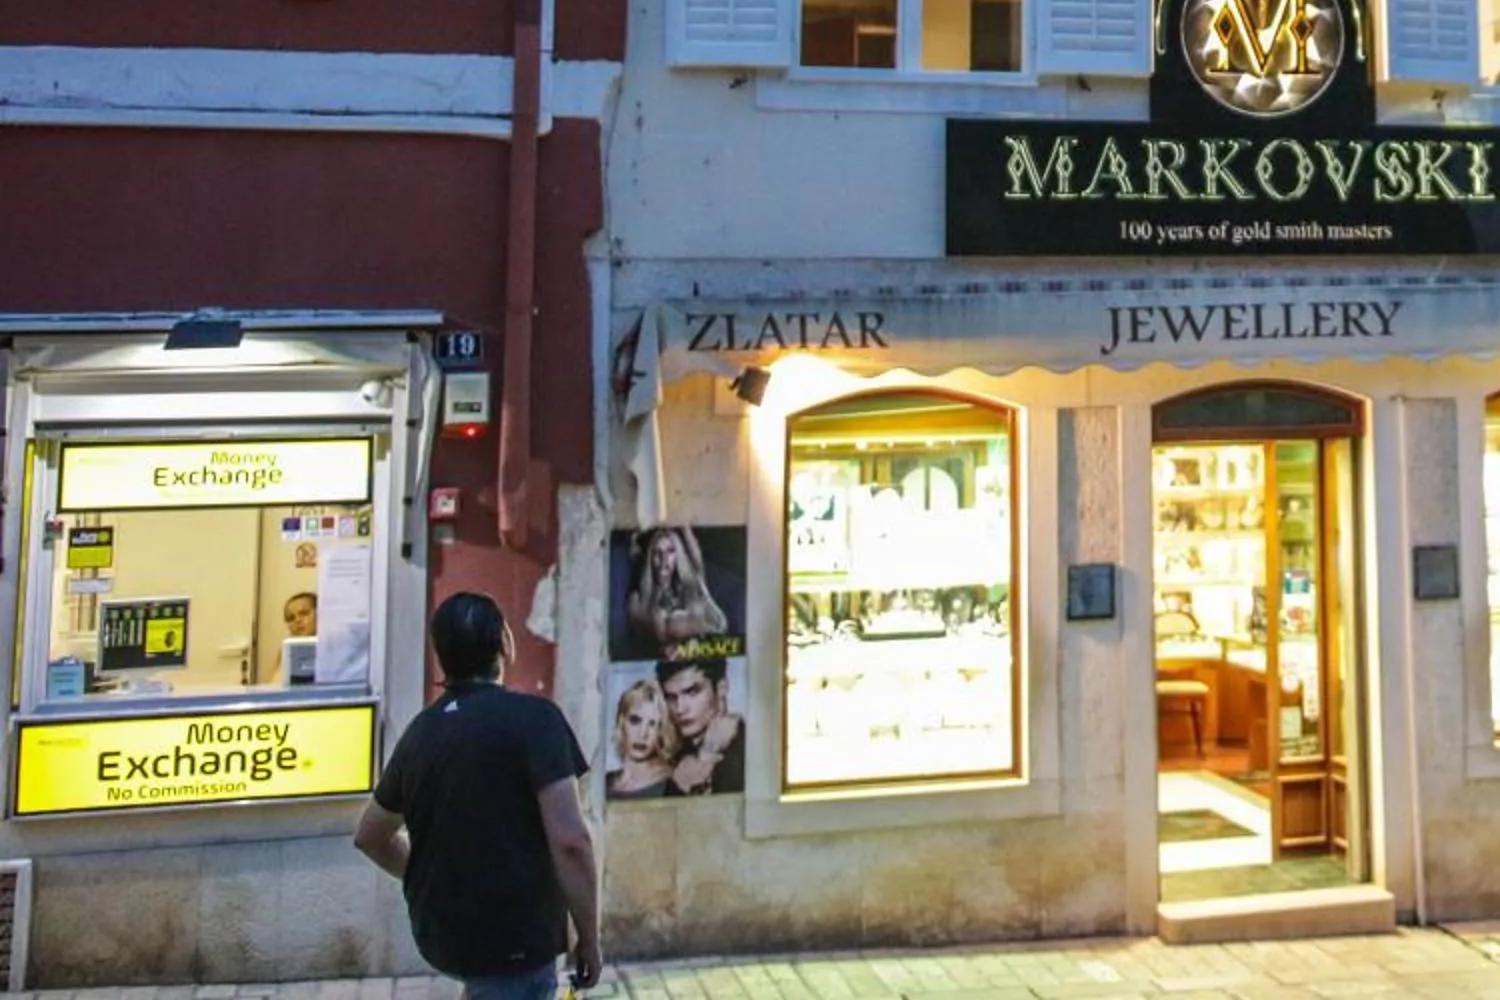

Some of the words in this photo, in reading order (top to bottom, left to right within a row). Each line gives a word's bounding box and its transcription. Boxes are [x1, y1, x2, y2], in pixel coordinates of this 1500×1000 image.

[1003, 136, 1497, 201] MARKOVSKI
[1119, 220, 1152, 240] 100
[1156, 224, 1204, 245] years
[1207, 220, 1230, 240] of
[1232, 220, 1271, 245] gold
[1275, 220, 1323, 240] smith
[1327, 222, 1393, 240] masters
[685, 310, 889, 351] ZLATAR
[1100, 300, 1404, 355] JEWELLERY
[447, 332, 475, 356] 19
[210, 451, 278, 468] Money
[153, 465, 284, 489] Exchange
[186, 722, 291, 747] Money
[97, 745, 299, 782] Exchange
[107, 785, 133, 801] No
[137, 780, 248, 800] Commission
